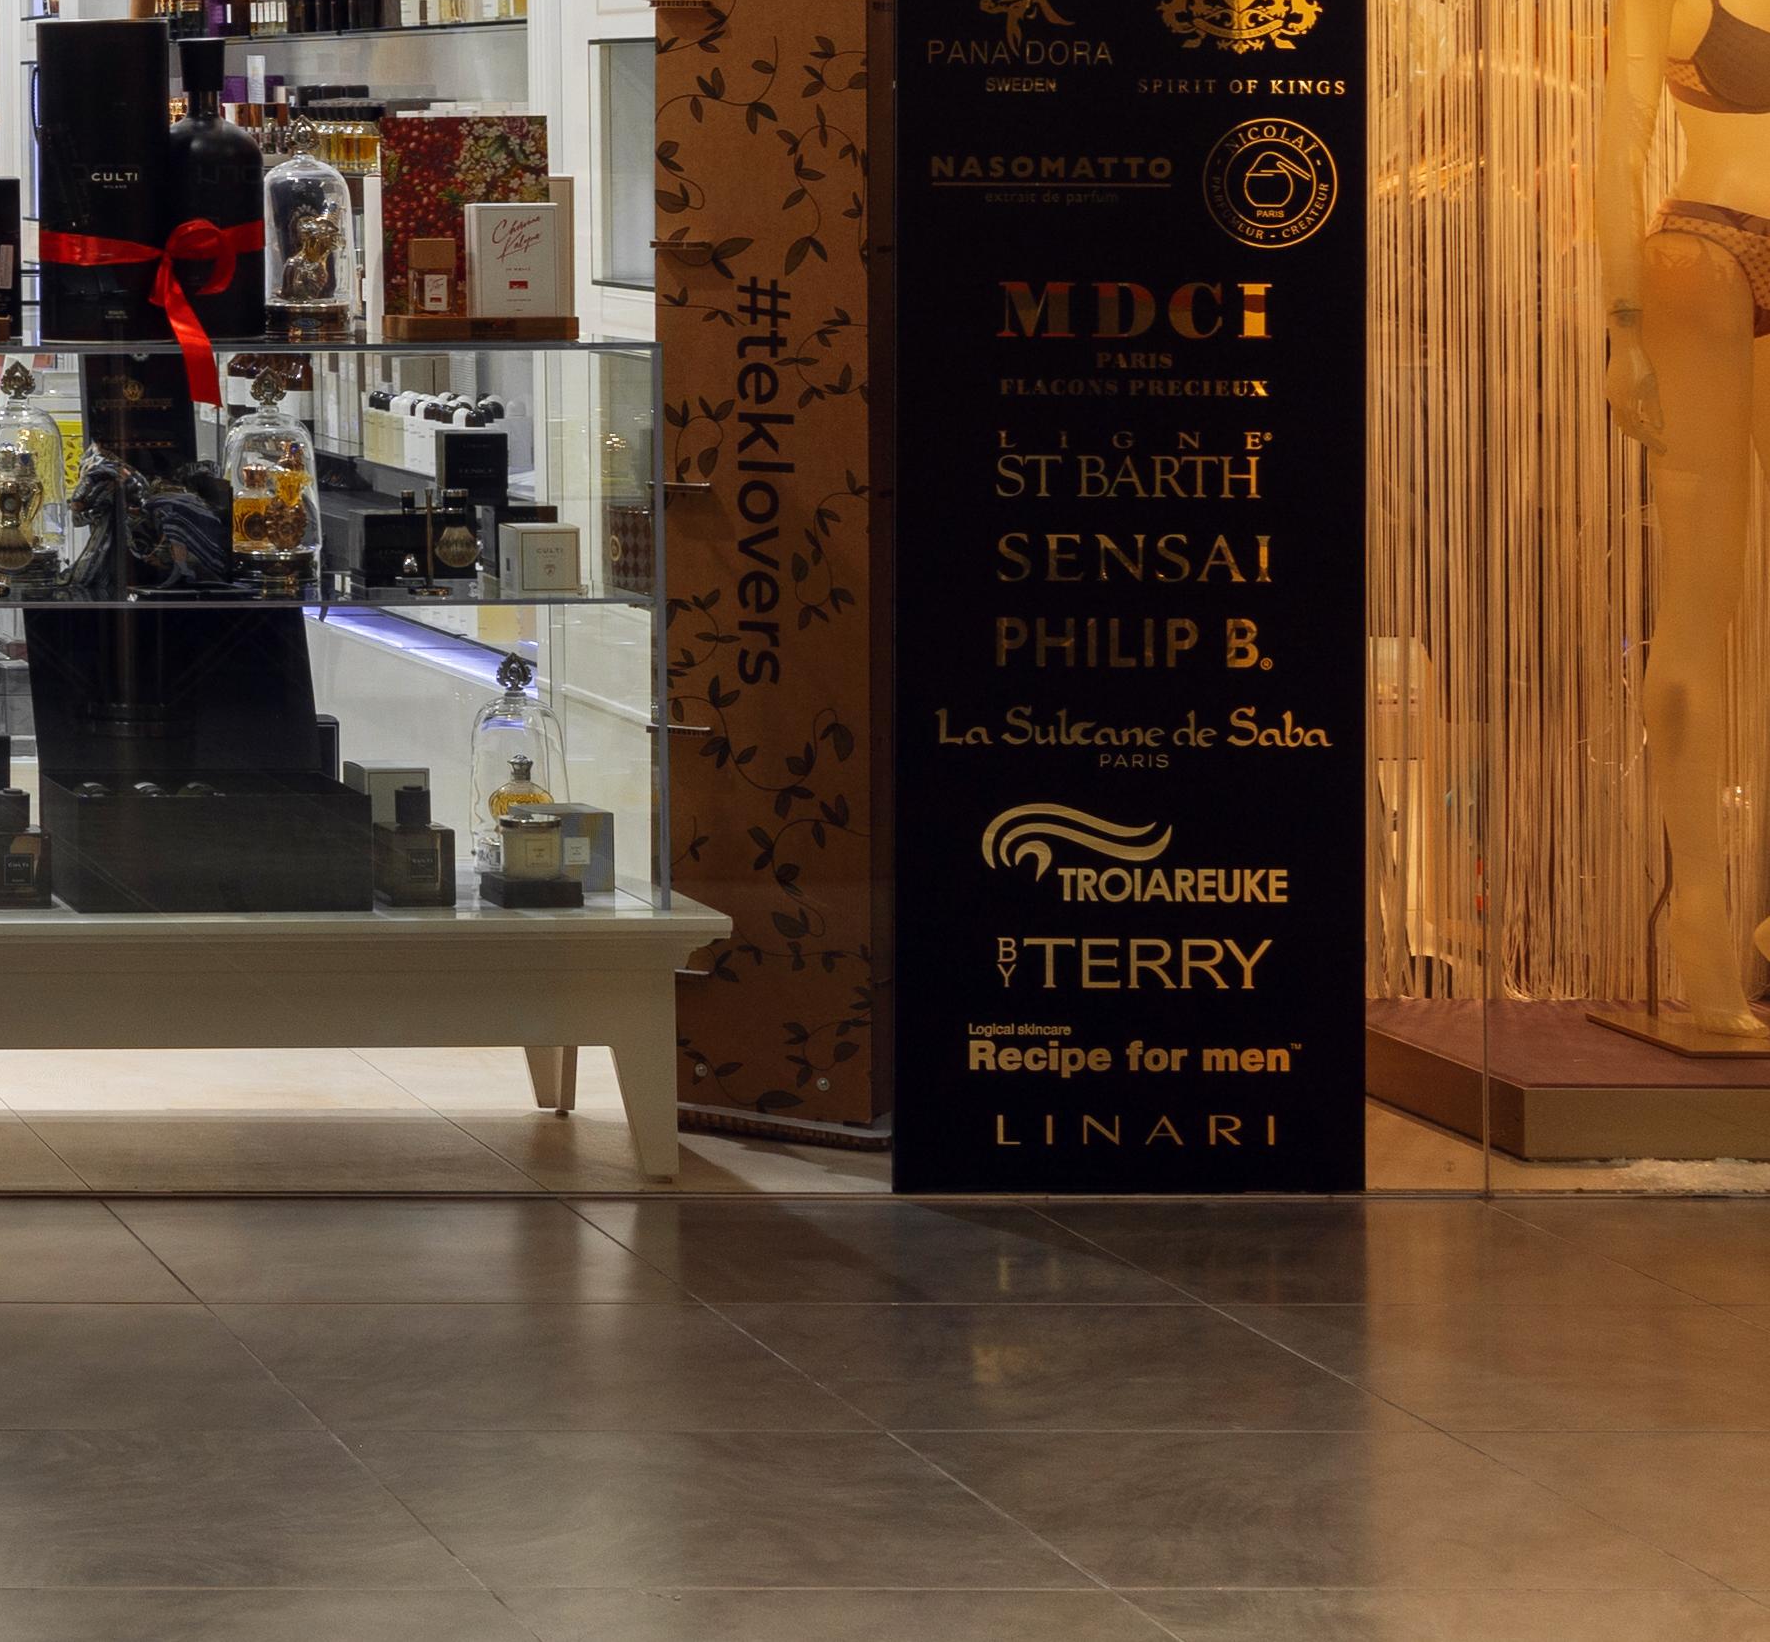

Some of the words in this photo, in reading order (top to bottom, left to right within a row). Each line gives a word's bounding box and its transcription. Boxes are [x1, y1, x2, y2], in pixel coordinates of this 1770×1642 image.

[985, 77, 1057, 93] SWEDEN
[1137, 78, 1218, 95] SPIRIT
[1229, 78, 1258, 95] OF
[1270, 79, 1347, 96] KINGS
[91, 172, 139, 182] CULTI
[931, 156, 1173, 179] NASOMATTO
[985, 190, 1036, 204] extrait
[1043, 190, 1059, 204] de
[1066, 190, 1119, 206] parfum
[1256, 209, 1285, 219] PARIS
[996, 282, 1272, 339] MDCI
[1096, 353, 1173, 370] PARIS
[1000, 379, 1118, 396] FLACONS
[1129, 380, 1269, 397] PRECIEUX
[737, 276, 795, 685] #teklovers
[996, 455, 1062, 498] ST
[1077, 456, 1261, 499] BARTH
[997, 532, 1272, 583] SENSAI
[996, 617, 1198, 668] PHILIP
[935, 708, 993, 745] La
[1172, 710, 1217, 747] de
[1227, 707, 1333, 747] Saba
[1100, 754, 1169, 768] PARIS
[1059, 868, 1288, 903] TROIAREUKE
[1023, 938, 1273, 989] TERRY
[969, 1023, 1015, 1038] Logical
[1018, 1023, 1071, 1036] skincare
[969, 1040, 1112, 1078] Recipe
[1126, 1040, 1188, 1072] for
[997, 1115, 1276, 1146] LINARI
